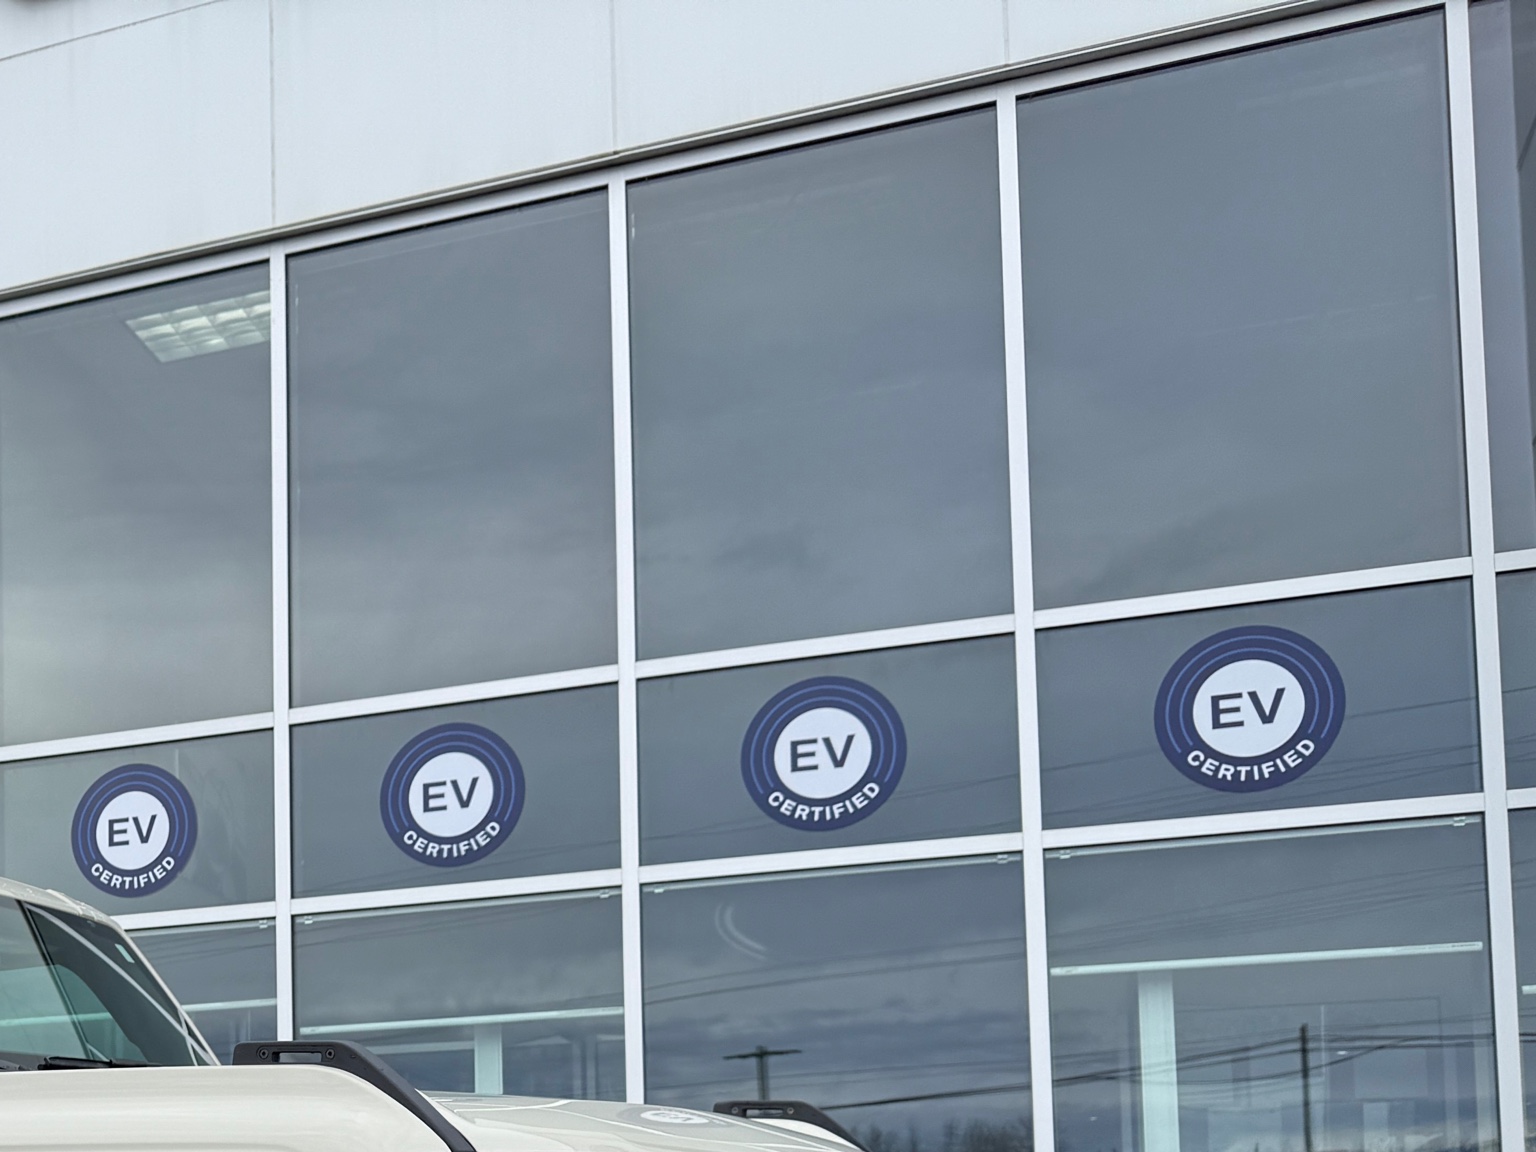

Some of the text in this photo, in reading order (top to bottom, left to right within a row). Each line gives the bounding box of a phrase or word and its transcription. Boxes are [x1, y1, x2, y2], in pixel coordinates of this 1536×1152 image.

[1210, 687, 1286, 730] EV
[789, 733, 856, 773] EV
[1186, 735, 1317, 782] CERTIFIED
[421, 776, 479, 813] EV
[767, 781, 881, 822] CERTIFIED
[107, 813, 158, 848] EV
[402, 819, 502, 859] CERTIFIED
[90, 855, 176, 891] CERTIFIED
